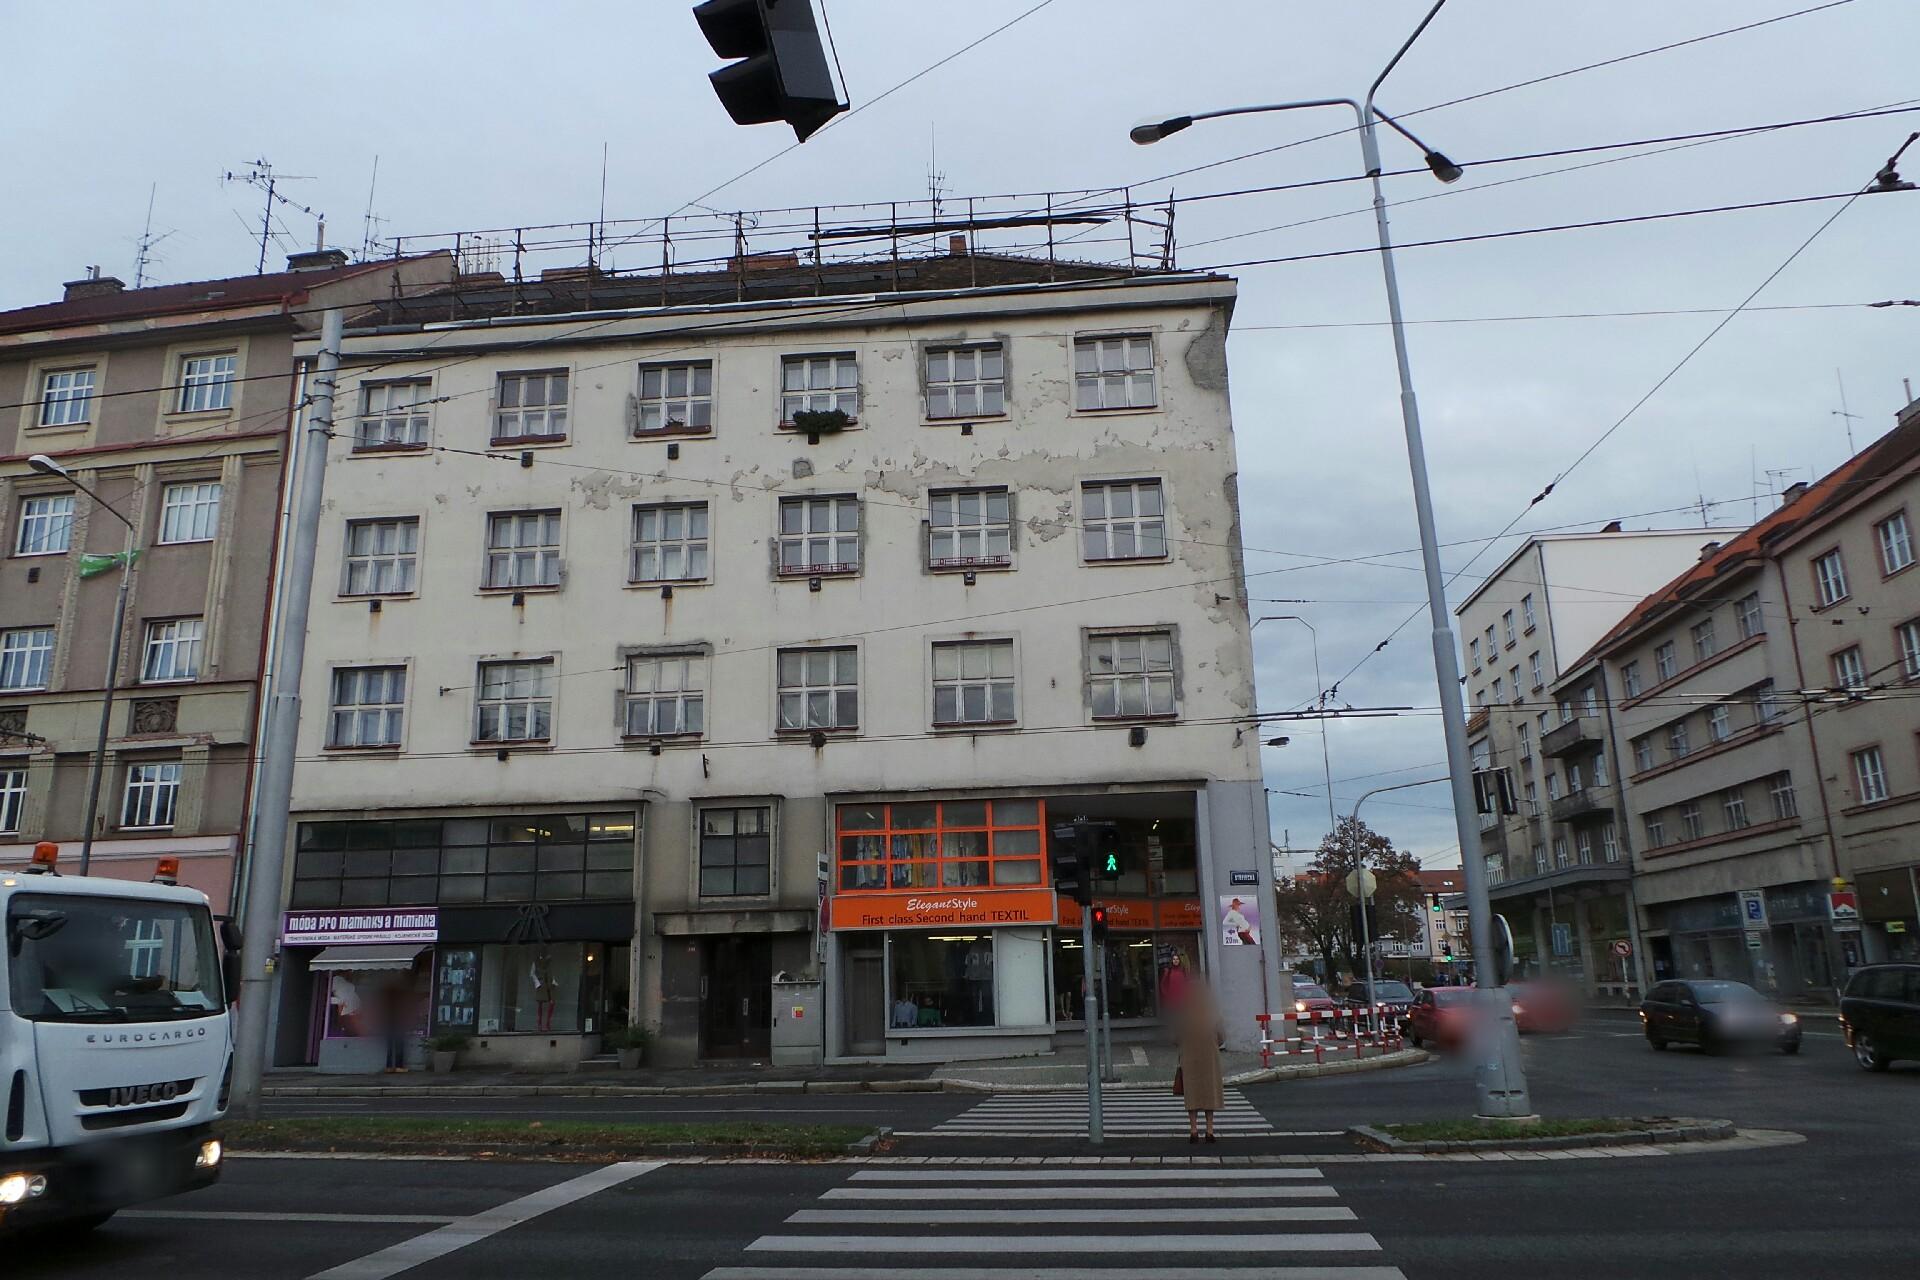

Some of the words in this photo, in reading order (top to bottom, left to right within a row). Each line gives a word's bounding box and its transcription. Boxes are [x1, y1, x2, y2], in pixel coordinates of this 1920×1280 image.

[862, 915, 884, 925] First
[888, 914, 913, 924] class
[916, 912, 954, 923] Second
[960, 911, 986, 922] hand
[991, 910, 1029, 921] TEXTIL
[87, 1027, 205, 1043] EUROCARGO
[108, 1081, 179, 1108] IVECO
